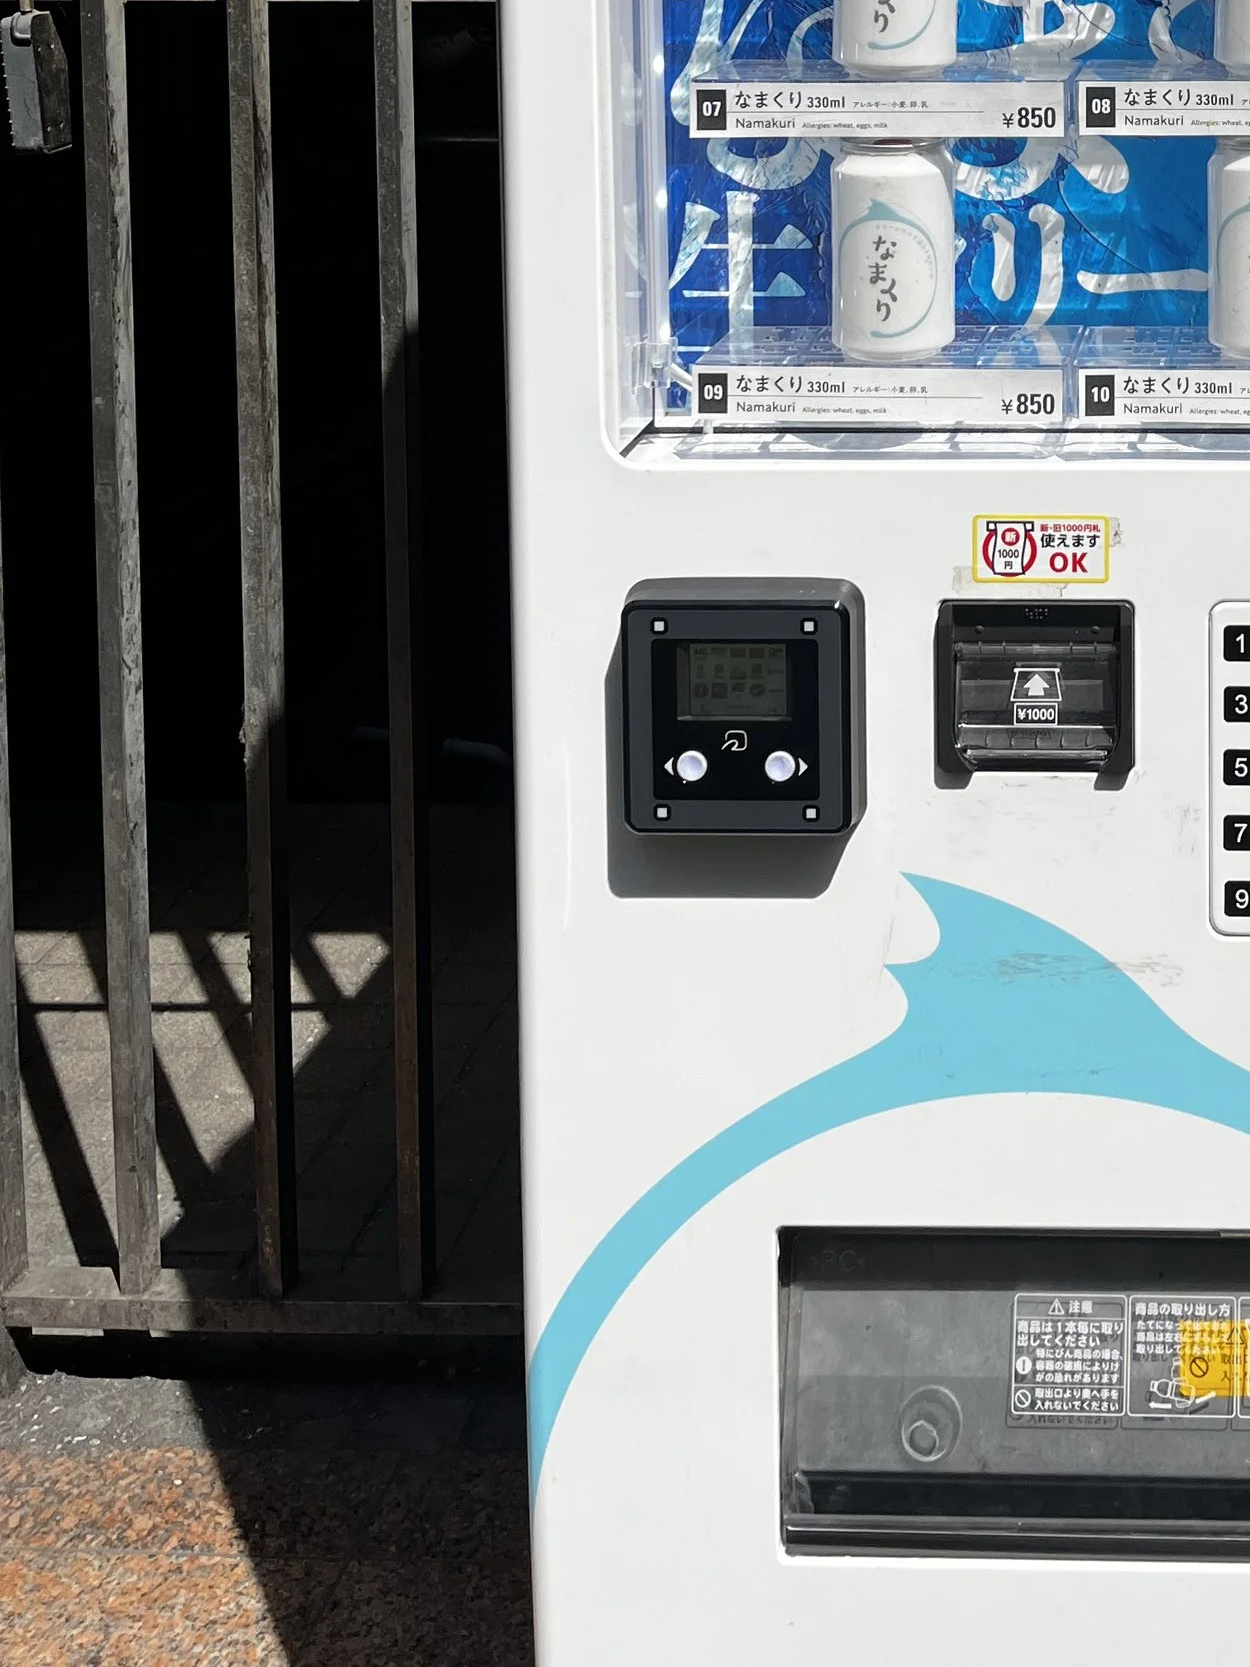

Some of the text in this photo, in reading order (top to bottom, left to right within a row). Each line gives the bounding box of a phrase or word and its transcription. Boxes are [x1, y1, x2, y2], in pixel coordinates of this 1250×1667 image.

[735, 90, 801, 109] なまくり
[807, 96, 845, 109] 330ml
[1124, 88, 1190, 106] なまくり
[1196, 93, 1234, 106] 330ml
[702, 102, 721, 117] 07
[1091, 99, 1110, 114] 08
[735, 117, 795, 129] Namakuri
[1002, 107, 1056, 129] ¥850
[1124, 114, 1184, 127] Namakuri
[869, 236, 898, 322] なまくり
[736, 375, 802, 393] なまくり
[807, 380, 845, 393] 330ml
[1123, 376, 1189, 395] なまくり
[1195, 381, 1232, 394] 330ml
[704, 385, 723, 401] 09
[1091, 386, 1109, 402] 10
[736, 400, 795, 413] Namakuri
[1001, 392, 1054, 415] ¥850
[1123, 402, 1182, 414] Namakuri
[1040, 533, 1100, 548] 使えます
[998, 549, 1019, 559] 1000
[1049, 552, 1088, 573] OK
[1004, 561, 1013, 570] 円
[1236, 634, 1246, 653] 1
[1234, 694, 1248, 714] 3
[1017, 708, 1055, 721] ¥1000
[1234, 758, 1248, 777] 5
[1234, 824, 1248, 842] 7
[1235, 889, 1249, 908] 9
[1135, 1302, 1230, 1316] 商品の取り出し方
